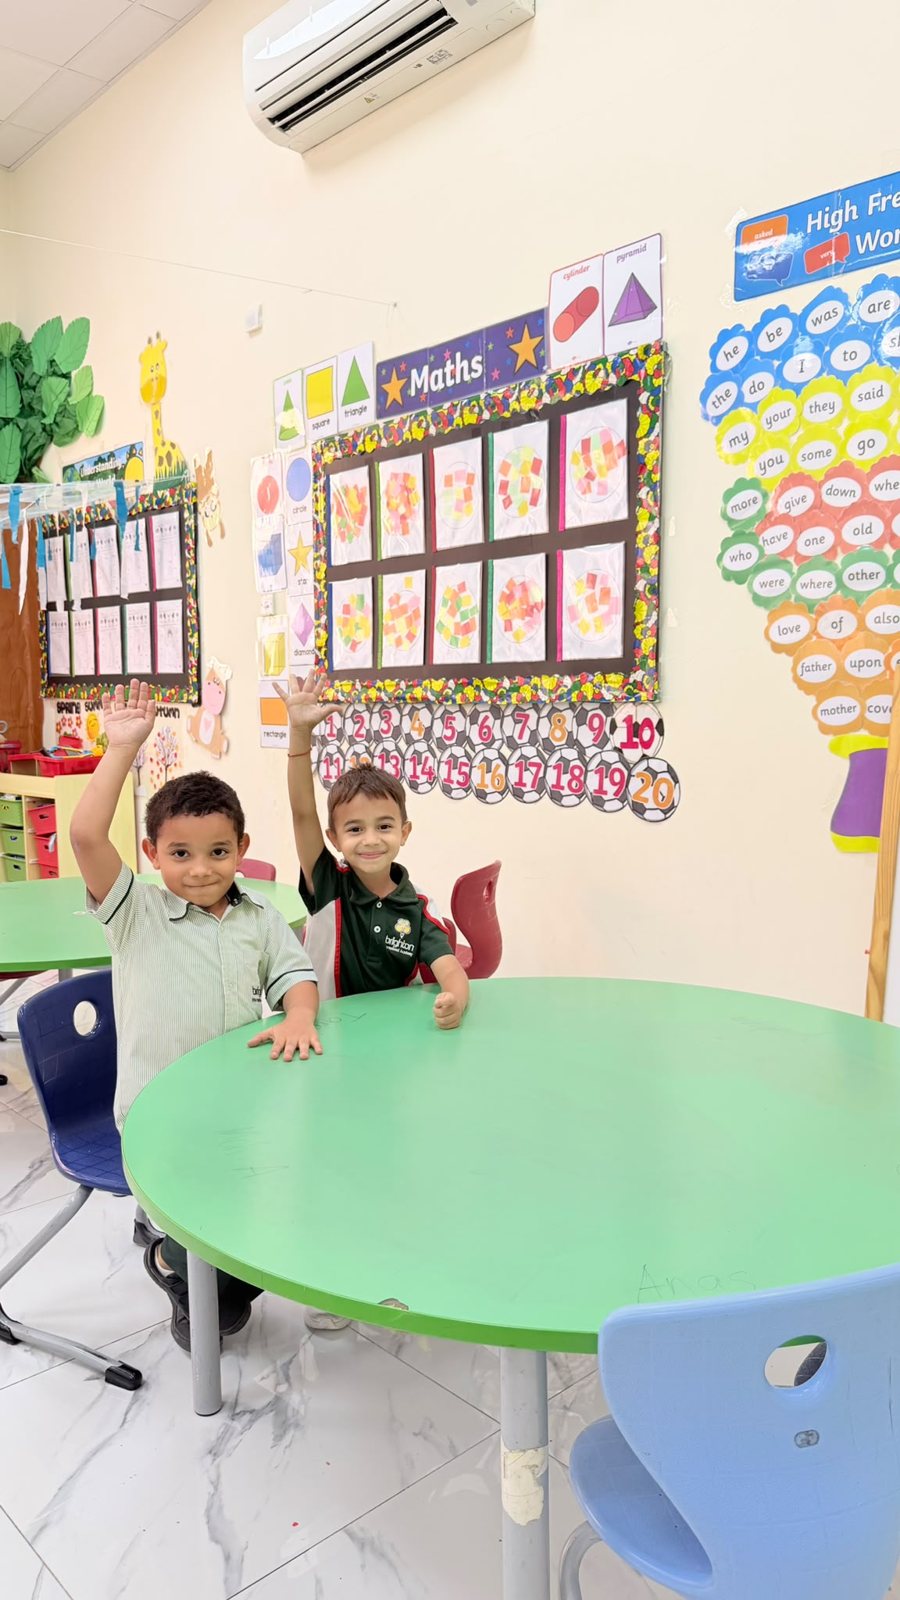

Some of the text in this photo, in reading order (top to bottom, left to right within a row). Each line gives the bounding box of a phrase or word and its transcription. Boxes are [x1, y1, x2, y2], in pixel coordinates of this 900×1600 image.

[806, 200, 858, 235] High
[754, 229, 773, 239] asked
[616, 243, 647, 264] pyramid
[562, 264, 590, 281] cylinder
[867, 298, 891, 314] are
[811, 306, 839, 329] was
[766, 326, 783, 343] be
[723, 344, 739, 362] he
[843, 349, 858, 362] to
[799, 359, 805, 373] I
[409, 351, 484, 398] Maths
[749, 379, 765, 395] do
[857, 385, 884, 402] said
[712, 388, 732, 410] the
[344, 405, 367, 417] triangle
[809, 401, 835, 415] they
[312, 418, 330, 430] square
[765, 406, 792, 429] your
[728, 430, 749, 448] my
[857, 438, 876, 456] go
[801, 448, 832, 462] some
[759, 454, 785, 476] you
[825, 485, 857, 498] down
[730, 495, 759, 514] more
[784, 494, 808, 513] give
[853, 522, 873, 536] old
[762, 531, 788, 547] have
[804, 535, 825, 547] one
[729, 548, 752, 562] who
[800, 577, 833, 589] where
[847, 569, 880, 581] other
[759, 578, 785, 589] were
[831, 616, 844, 633] of
[873, 612, 900, 624] also
[777, 624, 801, 636] love
[294, 648, 316, 657] diamond
[800, 661, 833, 677] father
[849, 658, 882, 672] upon
[820, 704, 857, 716] mother
[263, 729, 287, 738] rectangle
[326, 709, 655, 750] 1 2 3 4 5 6 7 8 9 10
[323, 757, 342, 780] 11
[378, 753, 401, 779] 13
[409, 755, 435, 781] 14
[443, 759, 470, 787] 15
[476, 763, 506, 791] 16
[514, 761, 542, 789] 17
[551, 763, 584, 793] 18
[593, 766, 625, 797] 19
[632, 772, 674, 808] 20
[385, 934, 415, 951] brighton
